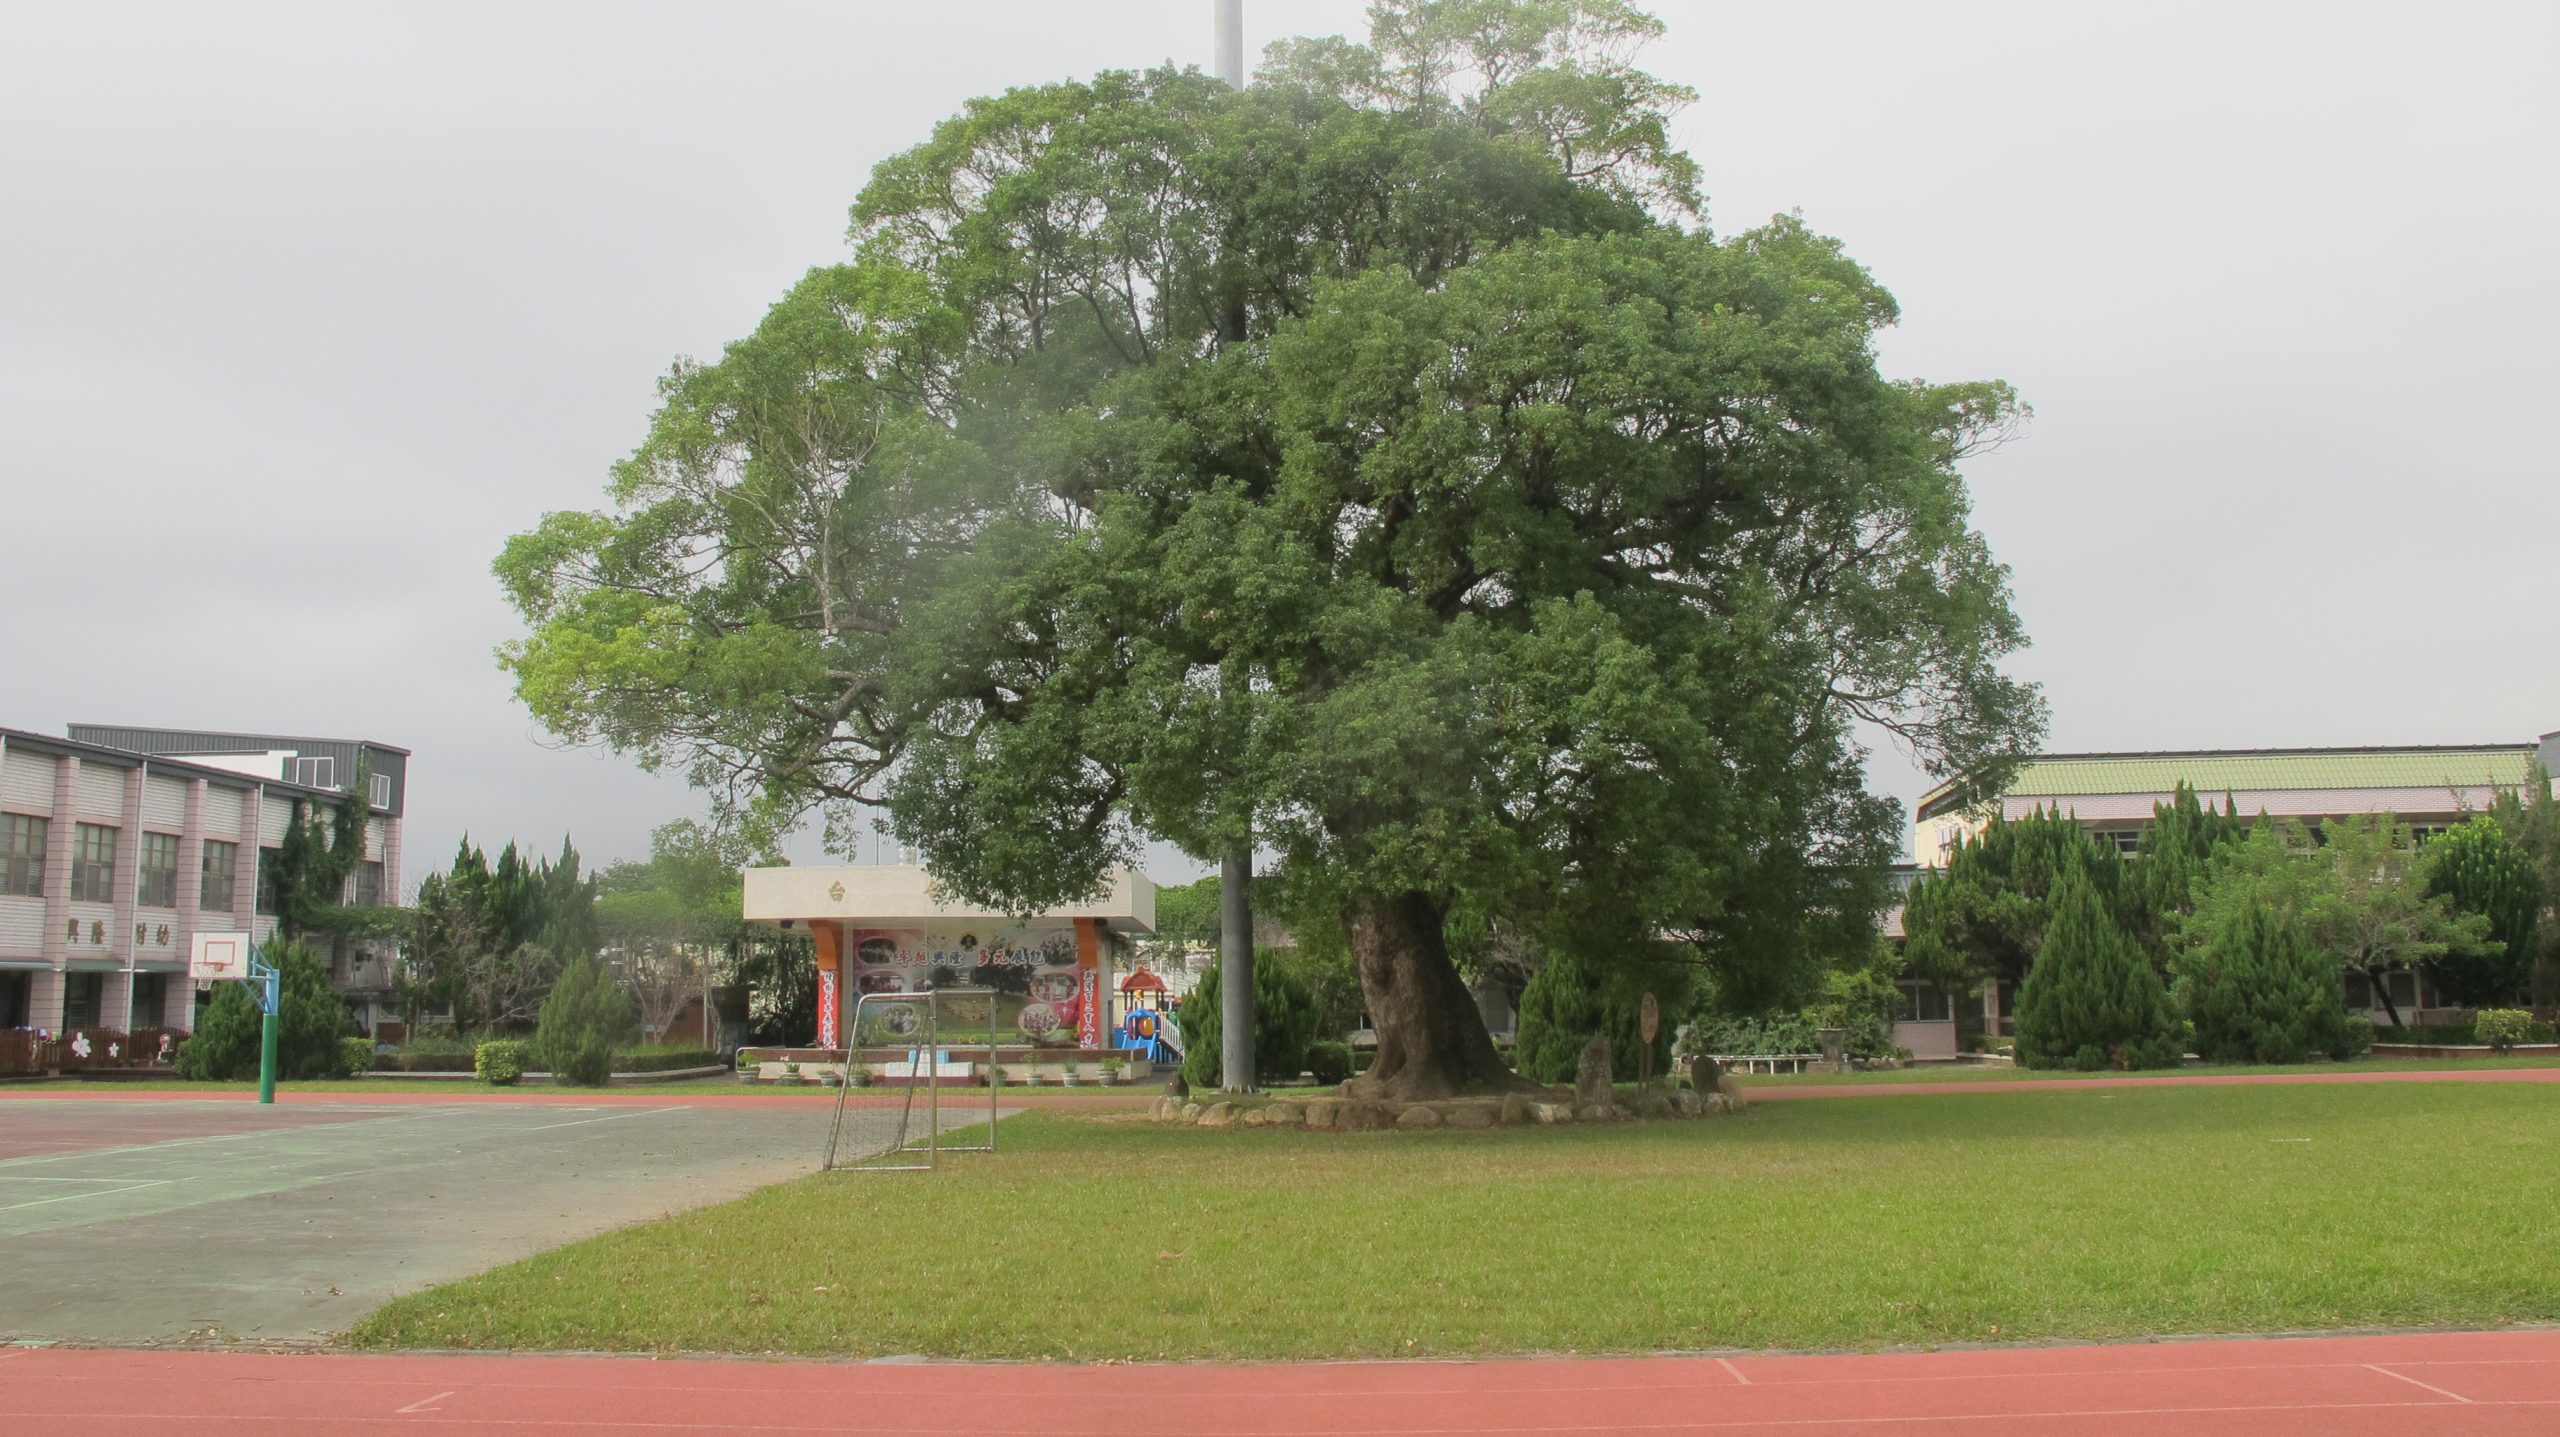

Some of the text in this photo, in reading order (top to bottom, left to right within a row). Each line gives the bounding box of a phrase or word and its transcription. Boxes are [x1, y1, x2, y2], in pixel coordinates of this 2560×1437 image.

[896, 948, 1045, 968] 卓越興隆 多元展能
